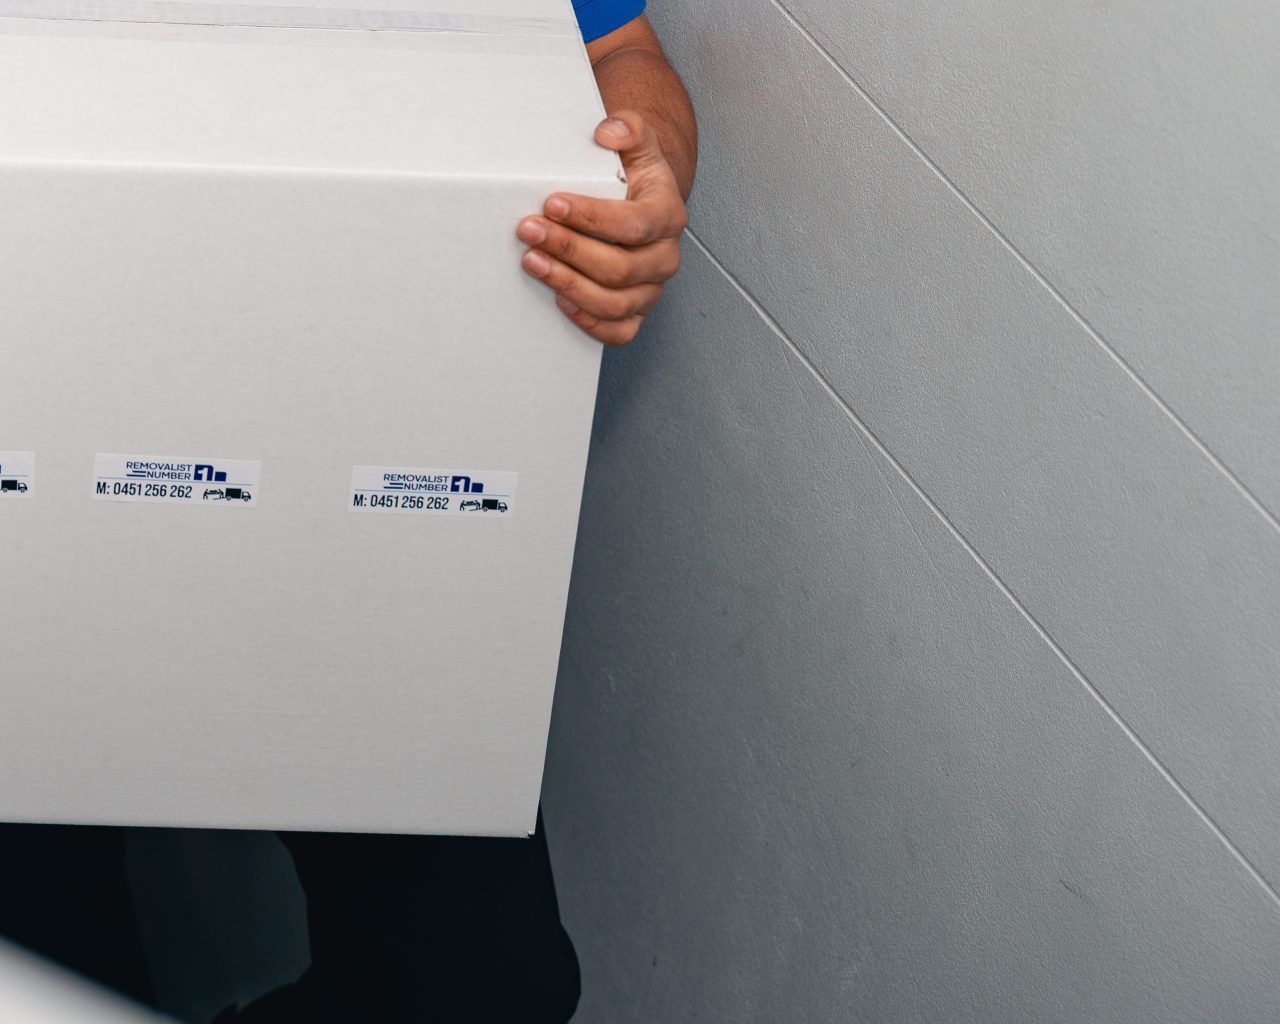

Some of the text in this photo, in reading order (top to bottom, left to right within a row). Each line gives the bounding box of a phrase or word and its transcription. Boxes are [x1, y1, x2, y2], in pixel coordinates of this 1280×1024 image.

[126, 461, 193, 472] REMOVALIST
[146, 471, 192, 480] NUMBER
[383, 474, 450, 483] REMOVALIST
[96, 482, 193, 499] M: 0451 256 262
[403, 484, 449, 492] NUMBER
[353, 494, 450, 510] M: 0451 256 262
